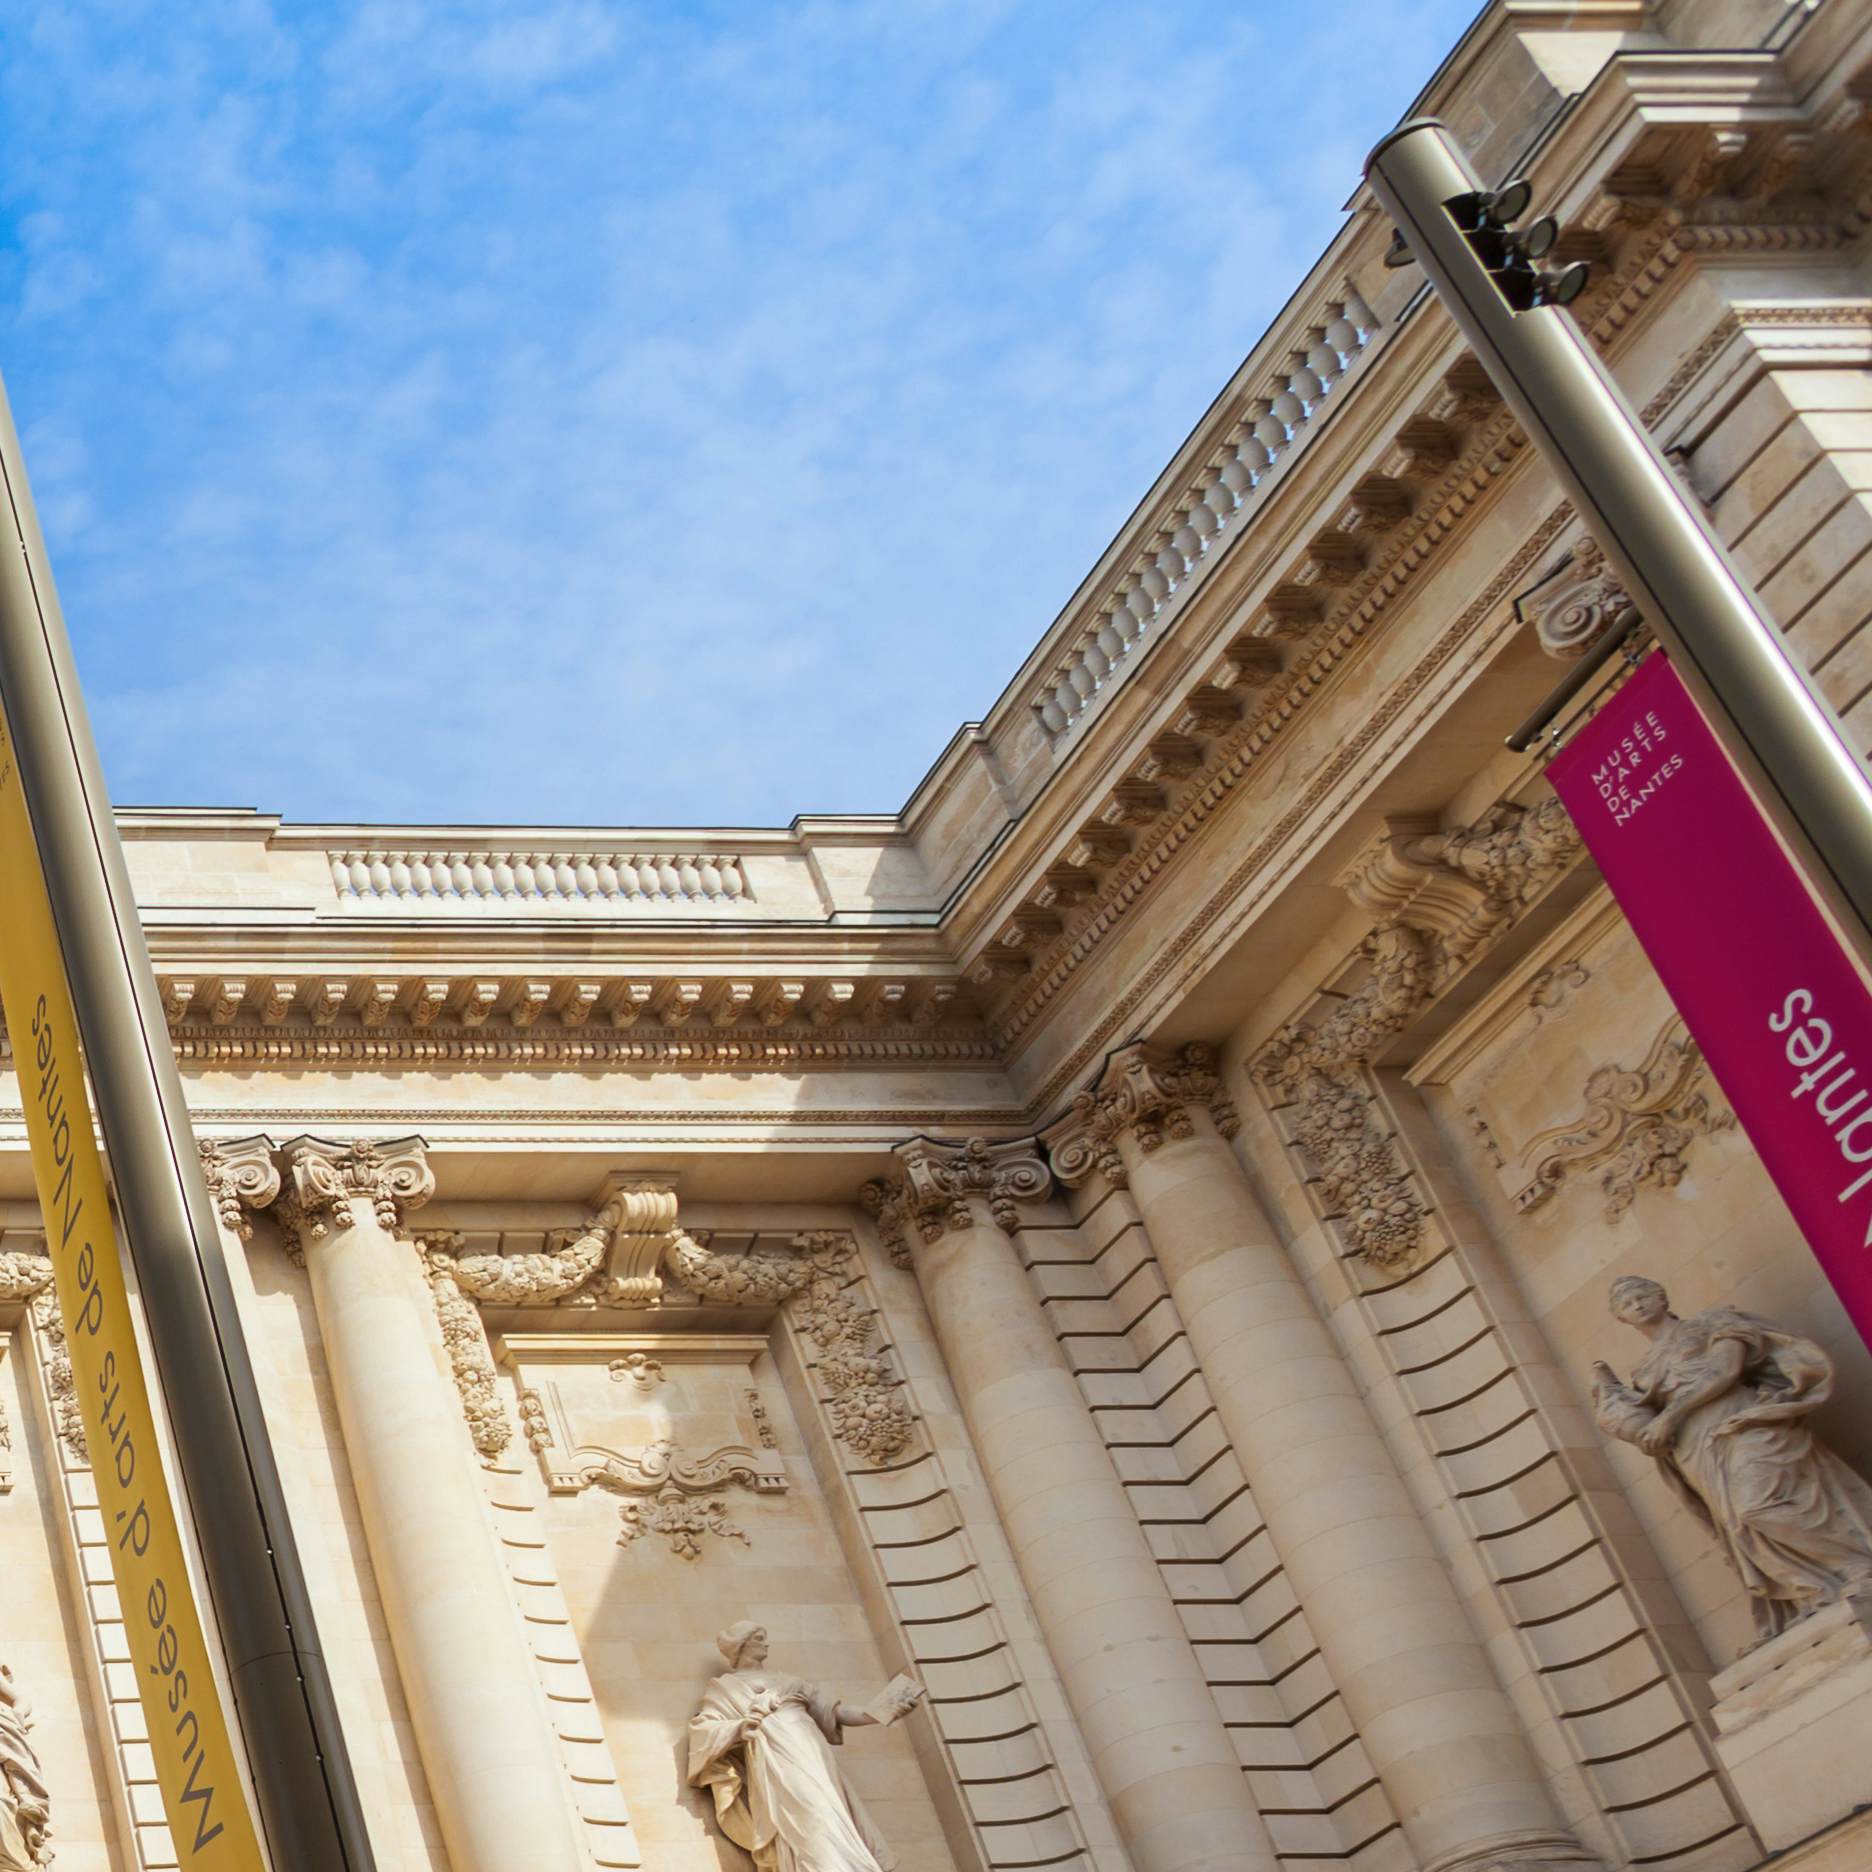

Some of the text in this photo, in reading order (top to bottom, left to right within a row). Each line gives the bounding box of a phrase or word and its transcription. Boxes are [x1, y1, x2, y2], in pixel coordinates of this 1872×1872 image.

[1591, 711, 1658, 785] MUSÉE
[1599, 726, 1667, 799] D'ARTS
[1606, 785, 1632, 813] DE
[1614, 754, 1684, 827] NANTES
[32, 994, 225, 1856] Musée d'arts de Nantes
